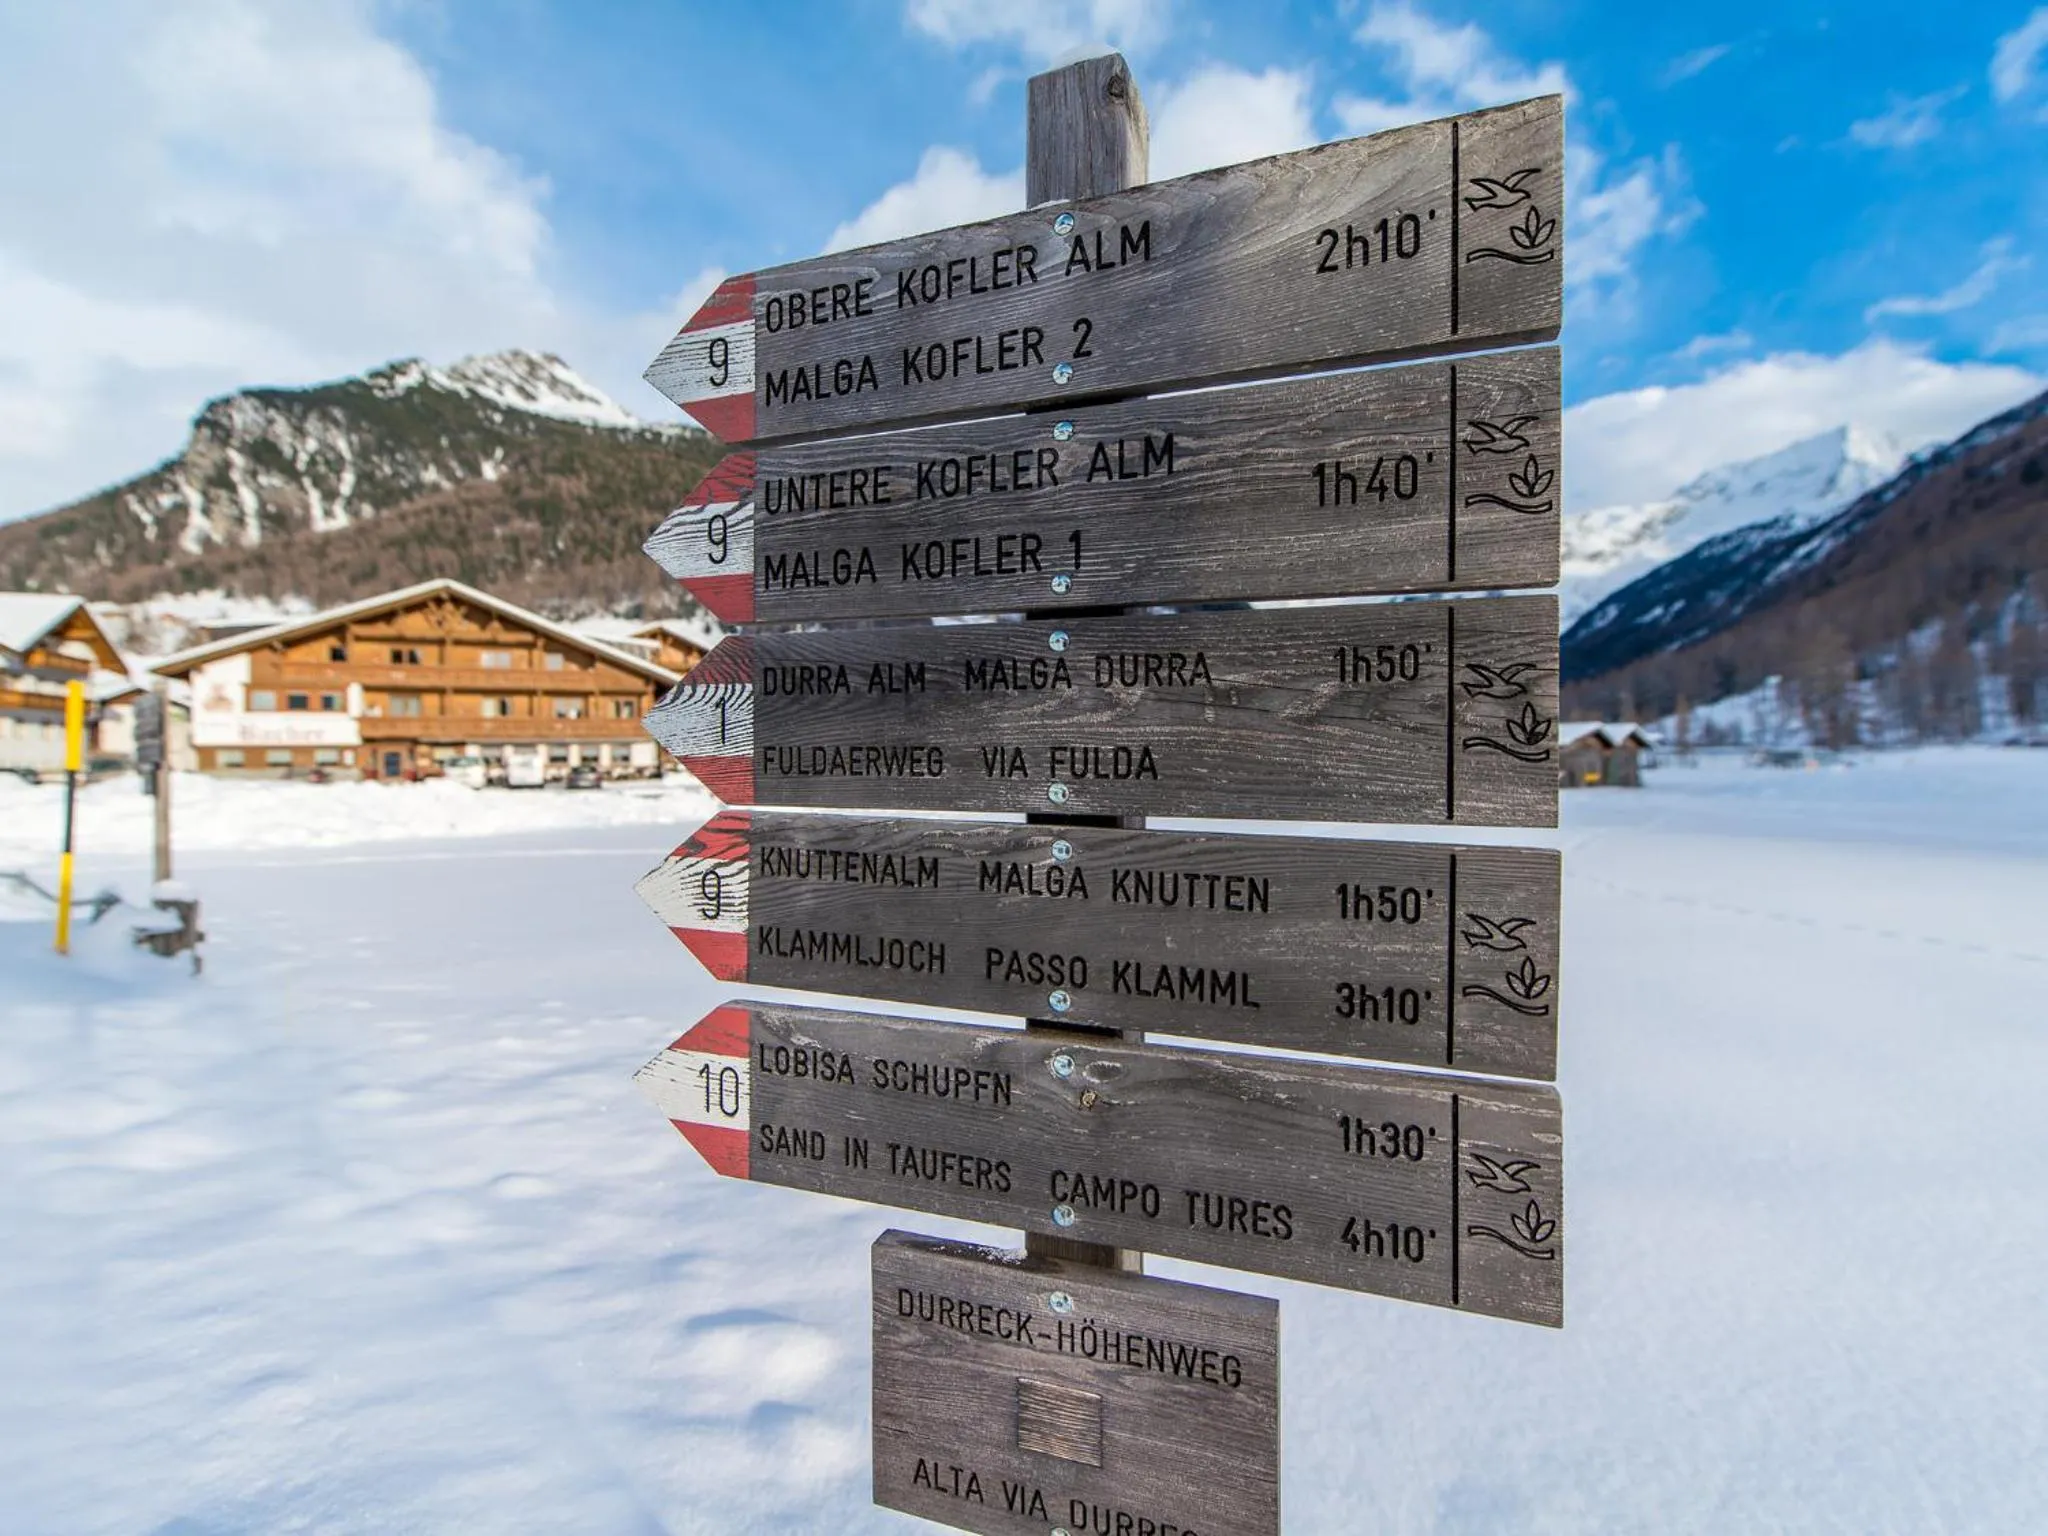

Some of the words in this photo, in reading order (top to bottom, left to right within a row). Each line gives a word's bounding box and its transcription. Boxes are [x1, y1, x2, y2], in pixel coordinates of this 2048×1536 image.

[1316, 209, 1437, 275] 2h10'
[765, 277, 873, 333] OBERE
[896, 244, 1038, 308] KOFLER
[1065, 220, 1151, 275] ALM
[708, 337, 729, 386] 9
[765, 355, 879, 407] MALGA
[903, 325, 1045, 386] KOFLER
[1072, 318, 1092, 359] 2
[764, 466, 892, 514] UNTERE
[917, 447, 1059, 501] KOFLER
[1086, 433, 1175, 481] ALM
[1311, 451, 1434, 507] 1h40'
[706, 513, 728, 565] 9
[764, 547, 877, 590] MALGA
[902, 532, 1042, 580] KOFLER
[1068, 529, 1083, 570] 1
[763, 663, 850, 696] DURRA
[868, 662, 925, 694] ALM
[965, 657, 1072, 691] MALGA
[1095, 651, 1213, 688] DURRA
[1334, 643, 1431, 684] 1h50'
[715, 697, 727, 745] 1
[763, 746, 944, 778] FULDAERWEG
[981, 746, 1028, 778] VIA
[1051, 745, 1159, 781] FULDA
[701, 870, 721, 920] 9
[760, 846, 940, 888] KNUTTENALM
[978, 860, 1089, 900] MALGA
[1111, 868, 1270, 914] KNUTTEN
[1335, 882, 1433, 925] 1h50'
[758, 925, 946, 975] KLAMMLJOCH
[985, 947, 1088, 989] PASSO
[1112, 959, 1260, 1010] KLAMML
[1335, 982, 1432, 1026] 3h10'
[699, 1062, 740, 1118] 10
[759, 1043, 854, 1085] LOBISA
[872, 1058, 1012, 1106] SCHUPFN
[1338, 1114, 1437, 1163] 1h30'
[760, 1123, 826, 1162] SAND
[845, 1136, 869, 1170] IN
[887, 1142, 1012, 1193] TAUFERS
[1050, 1169, 1161, 1219] CAMPO
[1184, 1188, 1294, 1241] TURES
[1340, 1215, 1437, 1264] 4h10'
[897, 1288, 1243, 1388] DURRECK-HÖHENWEG
[912, 1457, 984, 1503] ALTA
[1001, 1480, 1049, 1523] VIA
